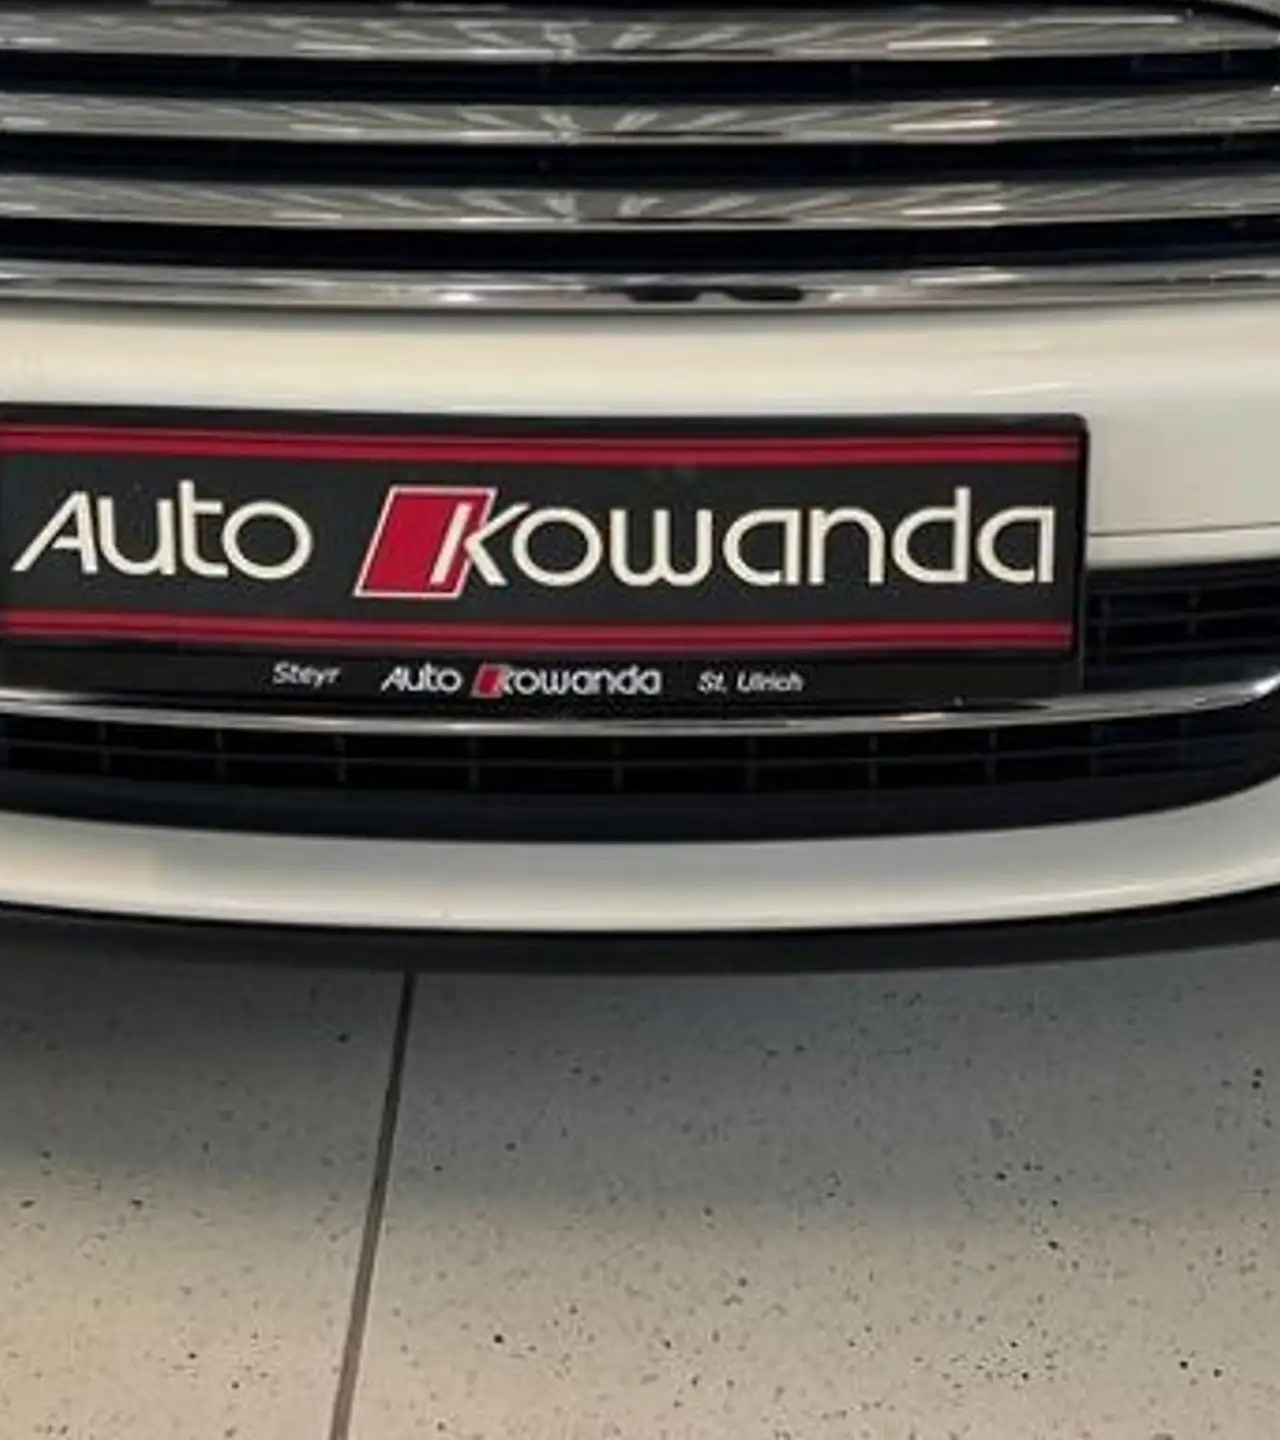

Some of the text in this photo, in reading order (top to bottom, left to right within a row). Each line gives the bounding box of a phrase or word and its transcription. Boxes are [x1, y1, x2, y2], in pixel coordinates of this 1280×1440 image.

[11, 479, 1057, 587] Auto Kowanda
[272, 661, 342, 688] Steyr
[380, 662, 463, 693] Auto
[736, 670, 804, 693] Ulrich
